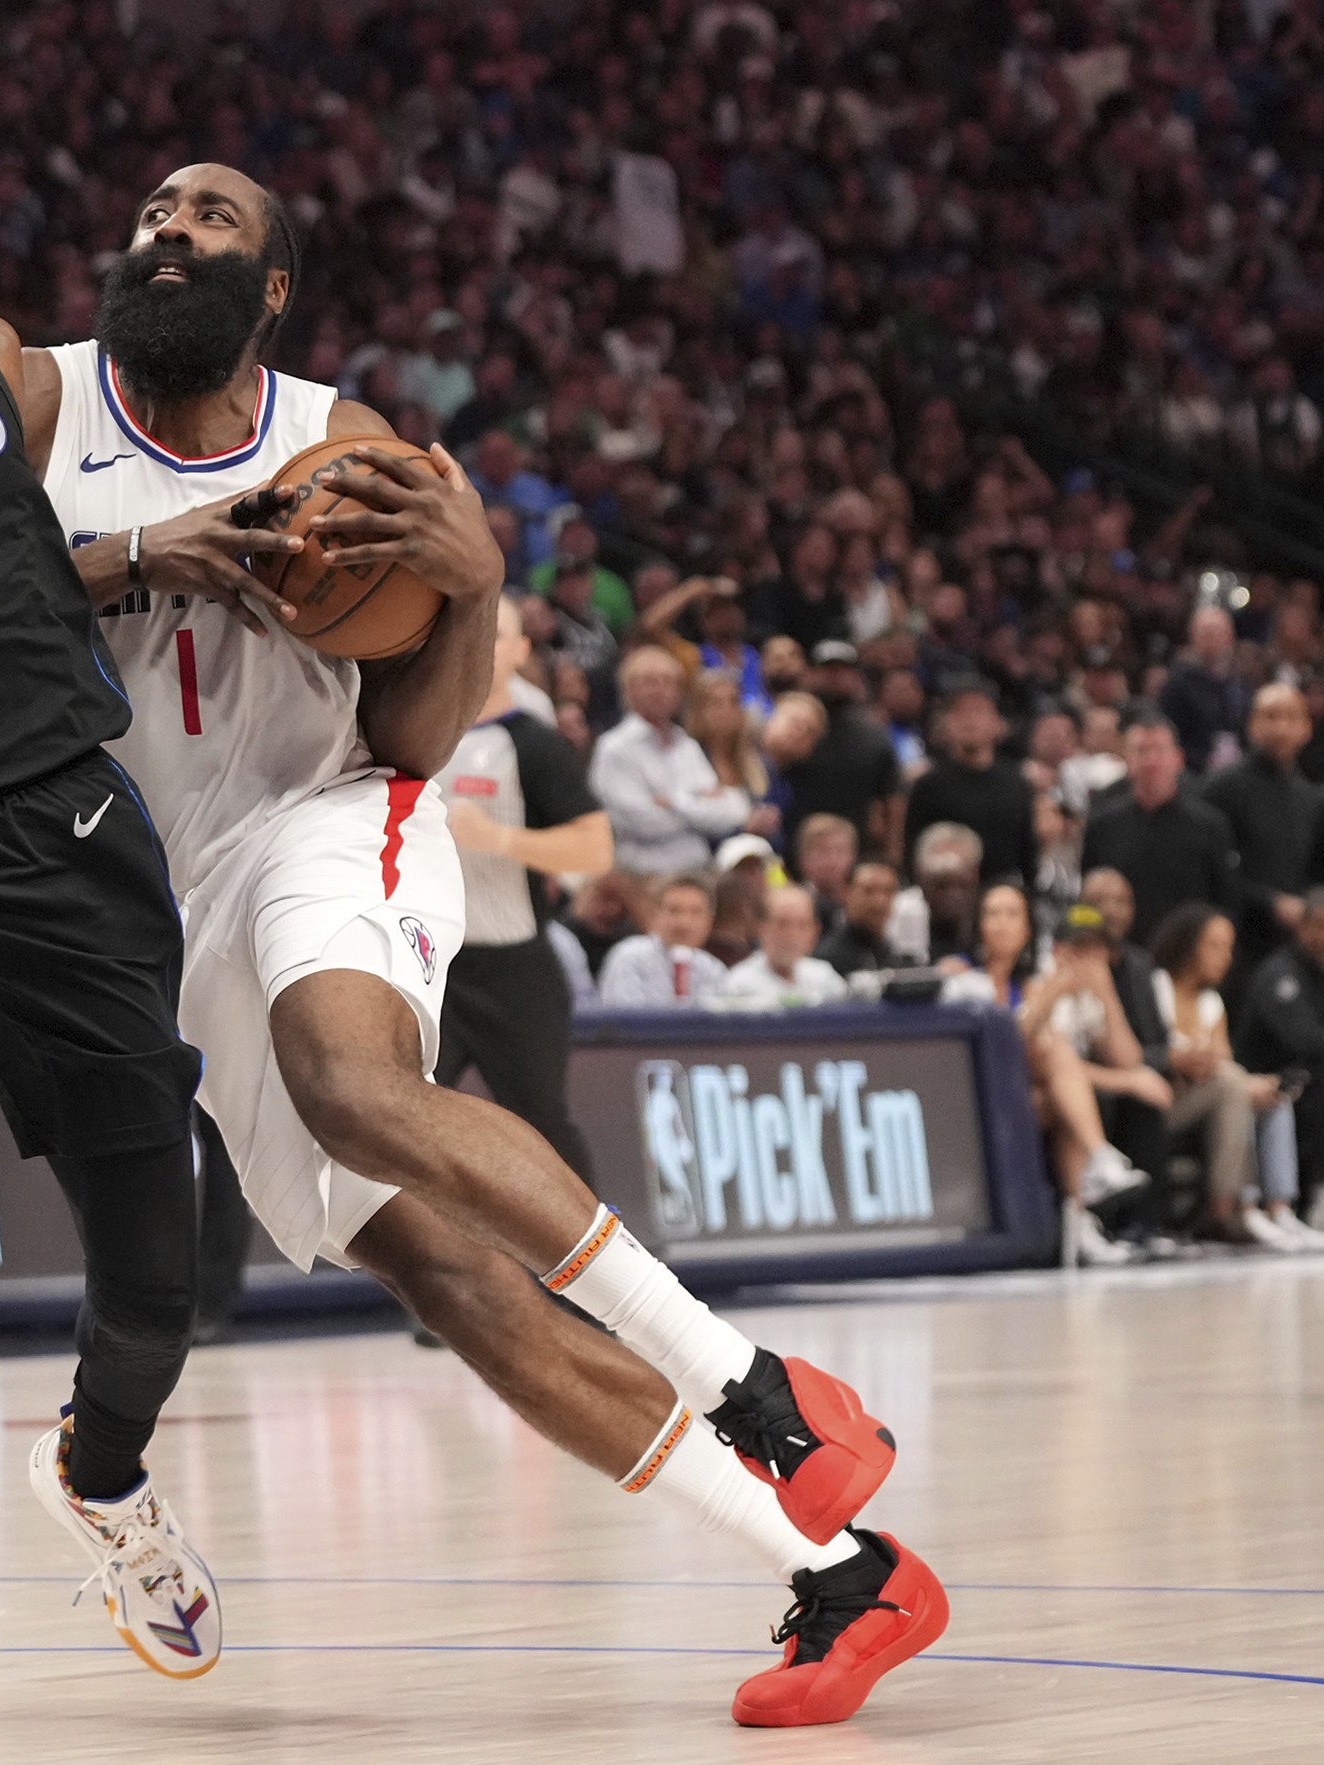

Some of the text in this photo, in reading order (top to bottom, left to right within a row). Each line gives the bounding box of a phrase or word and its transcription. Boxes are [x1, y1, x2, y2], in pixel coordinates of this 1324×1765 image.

[176, 627, 203, 736] 1
[546, 1239, 601, 1289] AUTHE
[664, 1413, 690, 1450] NBA
